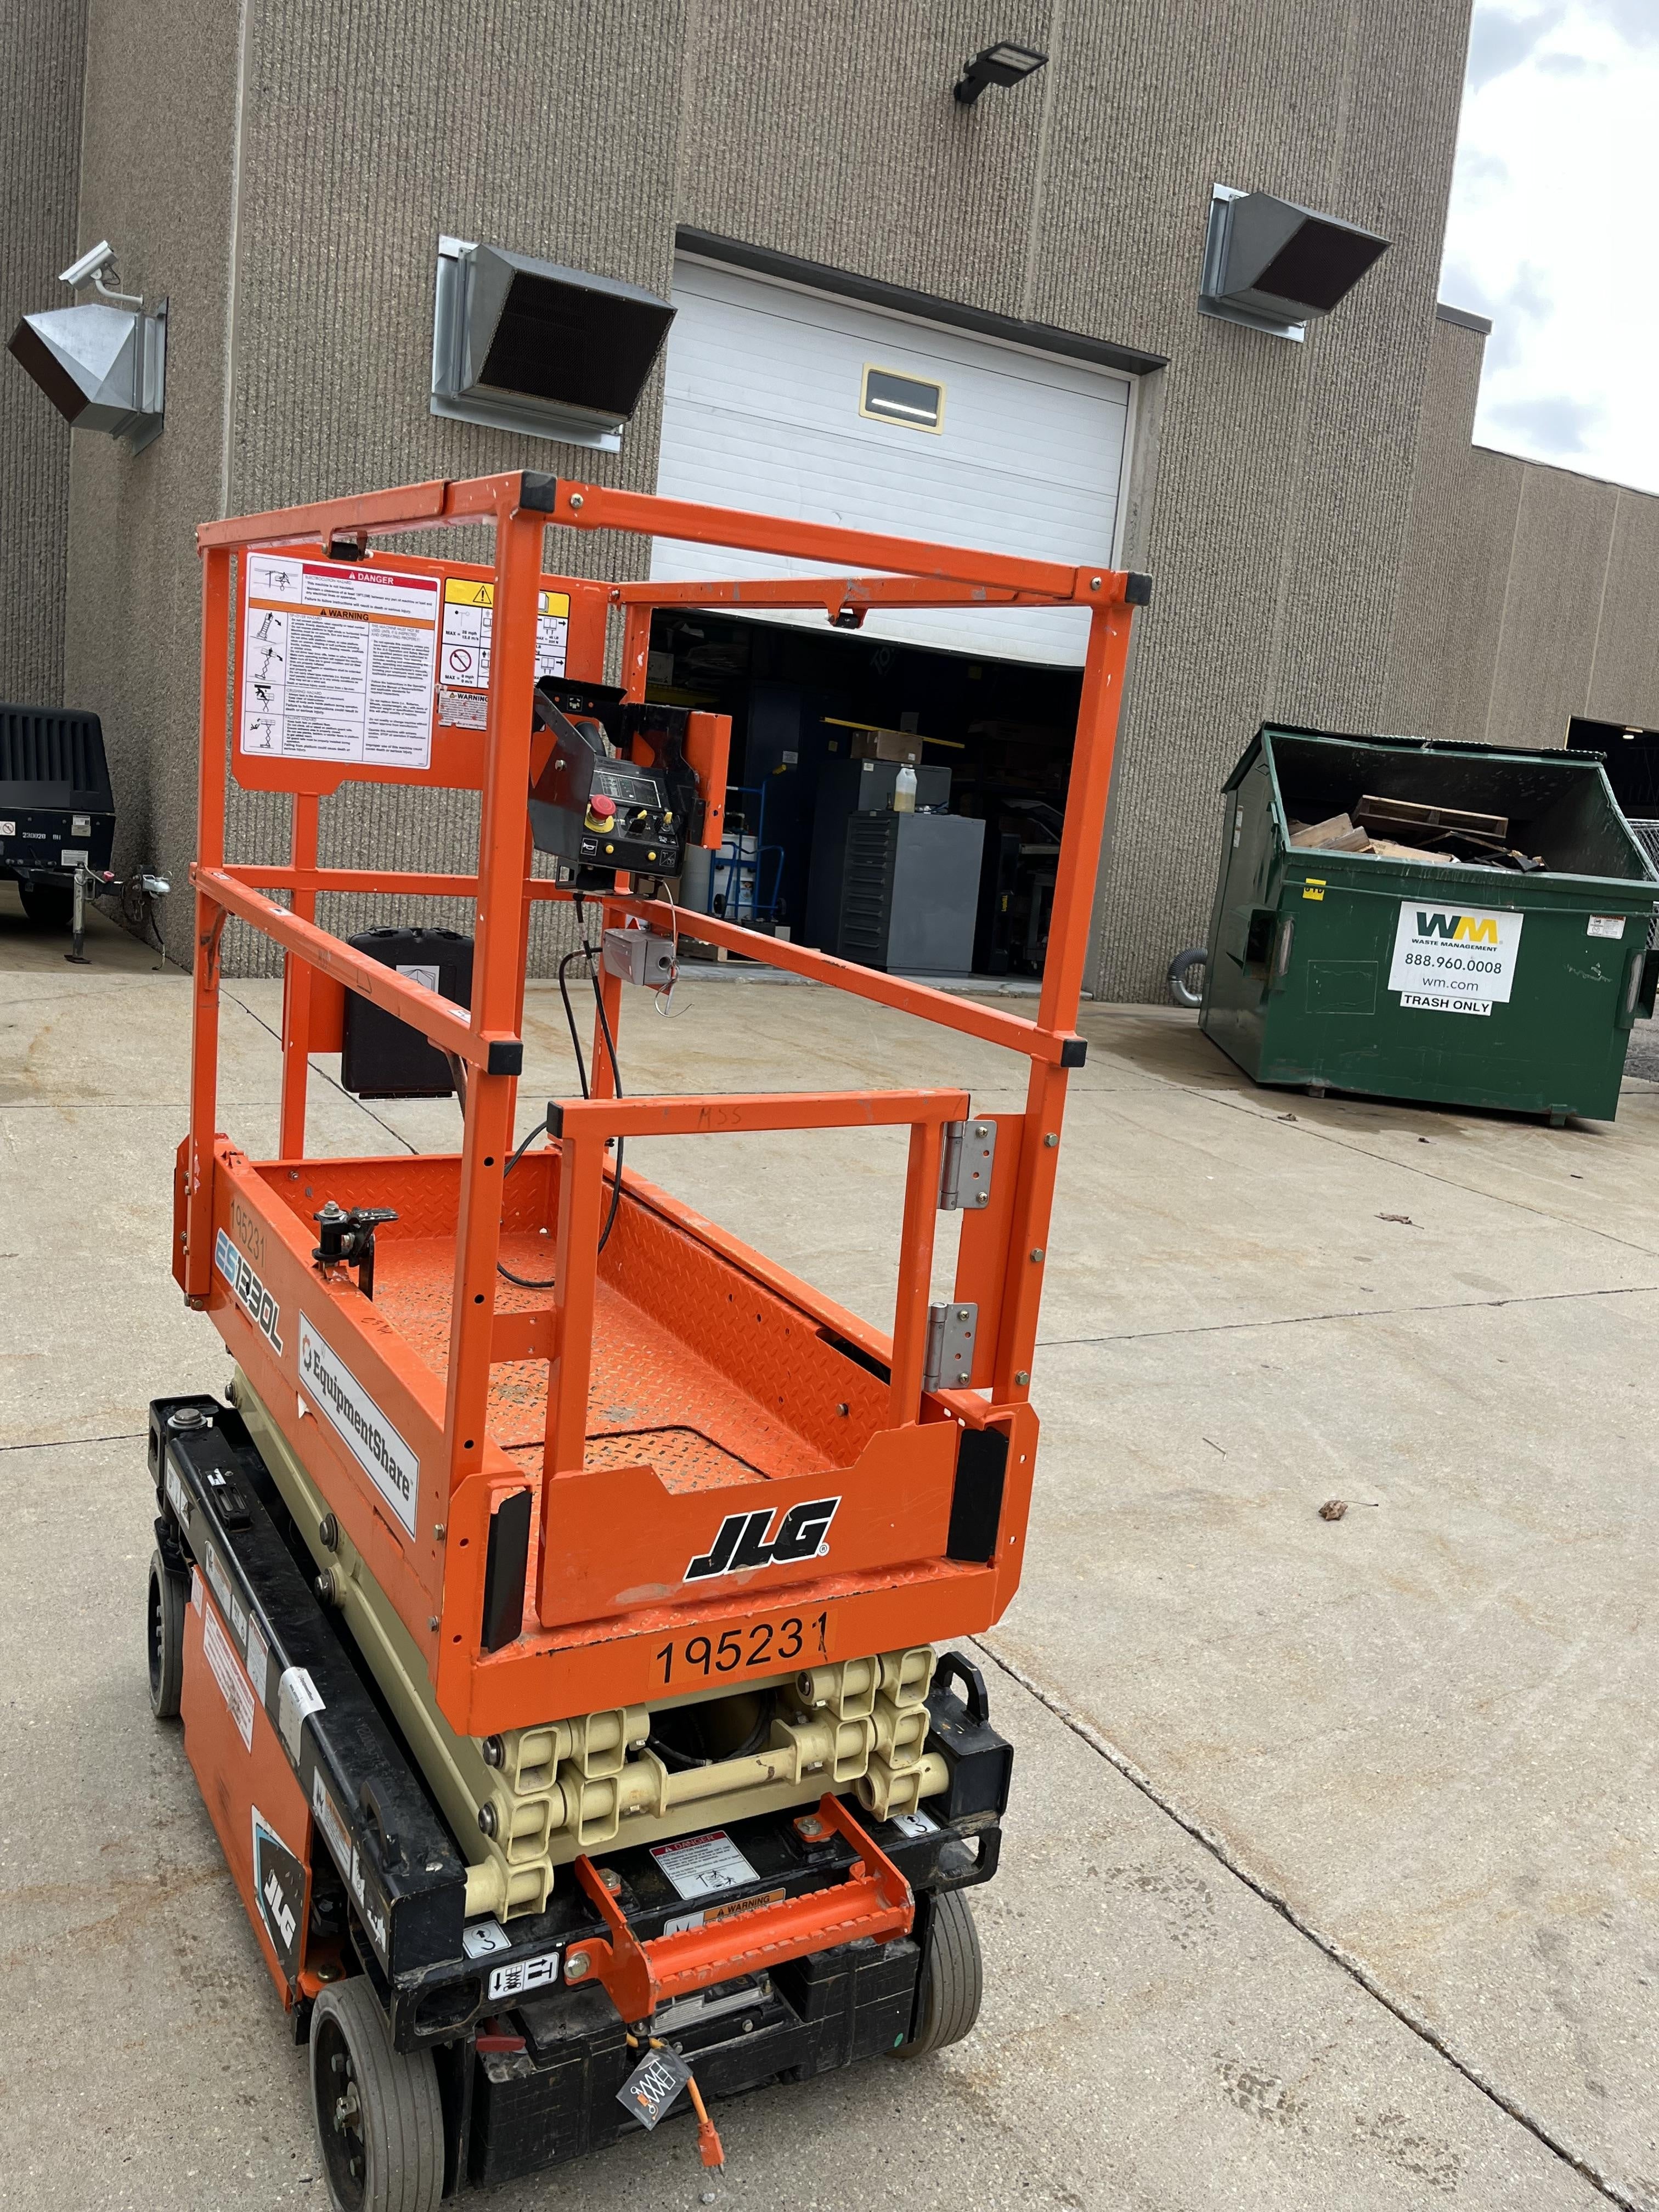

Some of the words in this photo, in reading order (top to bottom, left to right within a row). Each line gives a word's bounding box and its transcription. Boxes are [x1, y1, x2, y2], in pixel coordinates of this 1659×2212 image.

[358, 573, 394, 585] DANGER
[329, 610, 369, 620] WARNING
[1417, 912, 1498, 944] WM
[1440, 941, 1498, 952] MANAGEMENT
[1405, 953, 1502, 974] 888.960.0008
[1423, 978, 1479, 991] wm.com
[1404, 995, 1449, 1008] TRASH
[1454, 1000, 1489, 1013] ONLY
[231, 1200, 265, 1268] 195231
[216, 1228, 283, 1356] ES1330L
[313, 1349, 410, 1502] EquipmentShare
[684, 1497, 840, 1581] JLG
[657, 1611, 828, 1684] 195231
[674, 1835, 714, 1849] DANGER
[264, 1871, 297, 1949] JLG
[727, 1895, 770, 1913] WARNING
